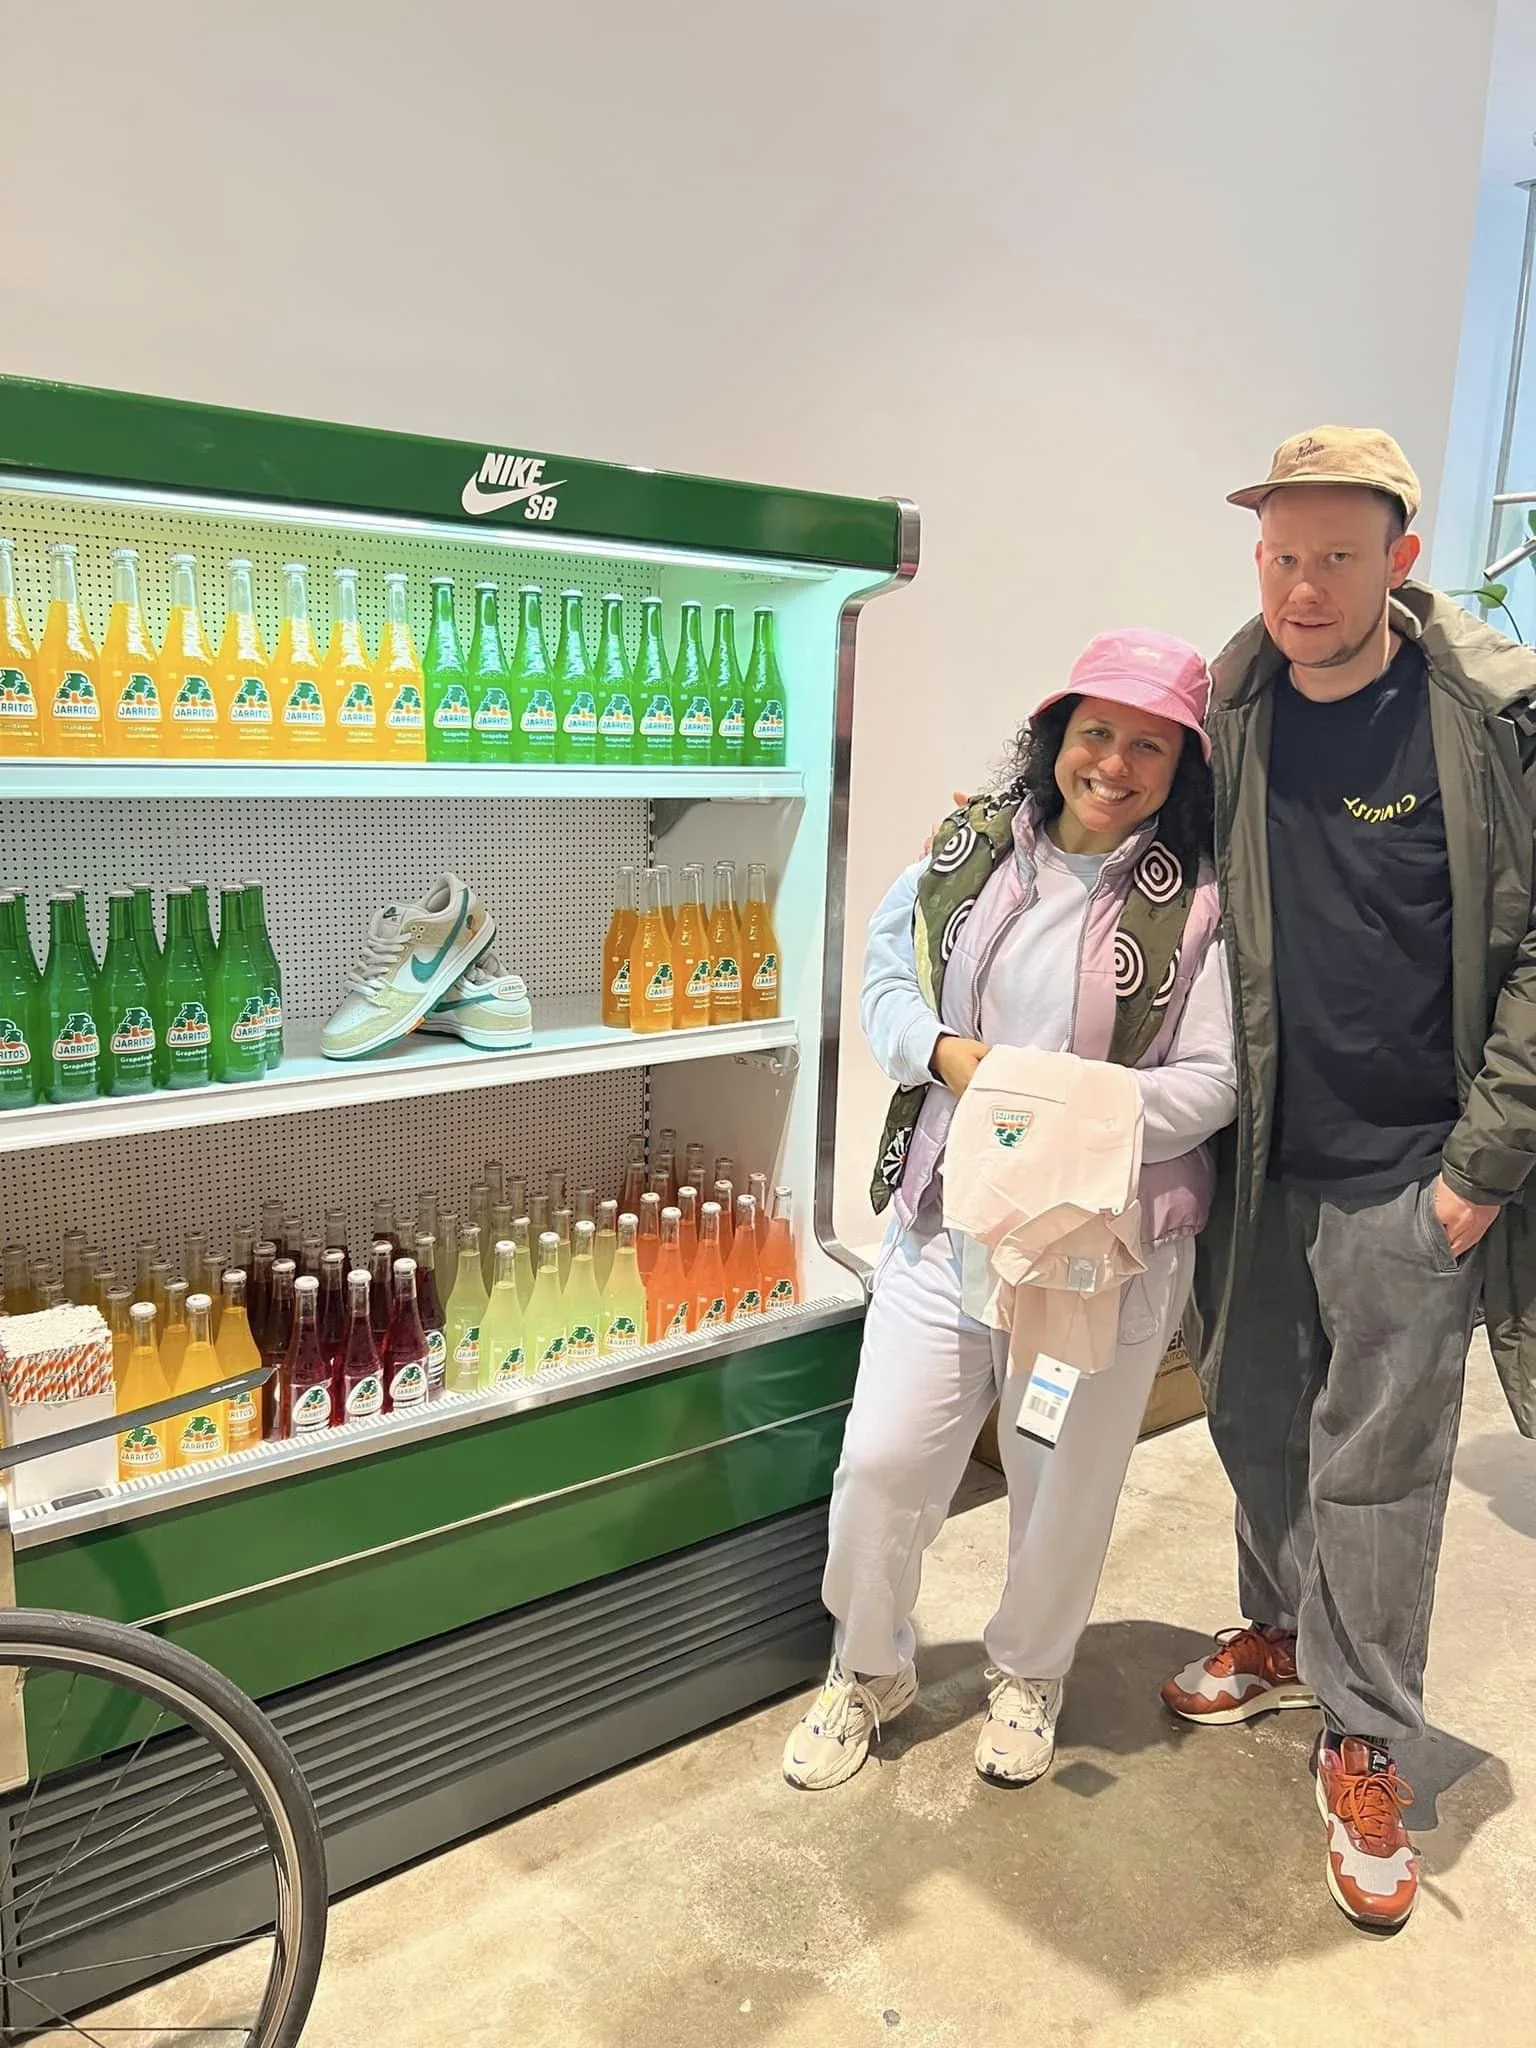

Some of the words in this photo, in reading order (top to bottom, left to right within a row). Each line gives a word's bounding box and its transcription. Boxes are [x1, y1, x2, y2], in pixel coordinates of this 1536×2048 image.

[478, 452, 546, 488] NIKE
[524, 494, 558, 521] SB
[0, 703, 33, 713] RRITOS
[54, 705, 97, 715] JARRITOS
[174, 707, 215, 718] JARRITOS
[1342, 794, 1417, 824] CIVILIST
[171, 1031, 209, 1042] JARRITOS
[57, 1042, 97, 1055] JARRITOS
[567, 1347, 595, 1355] ARRITOS
[230, 1408, 253, 1418] RITOS
[181, 1439, 219, 1449] JARRITOS
[121, 1451, 160, 1460] JARRITOS
